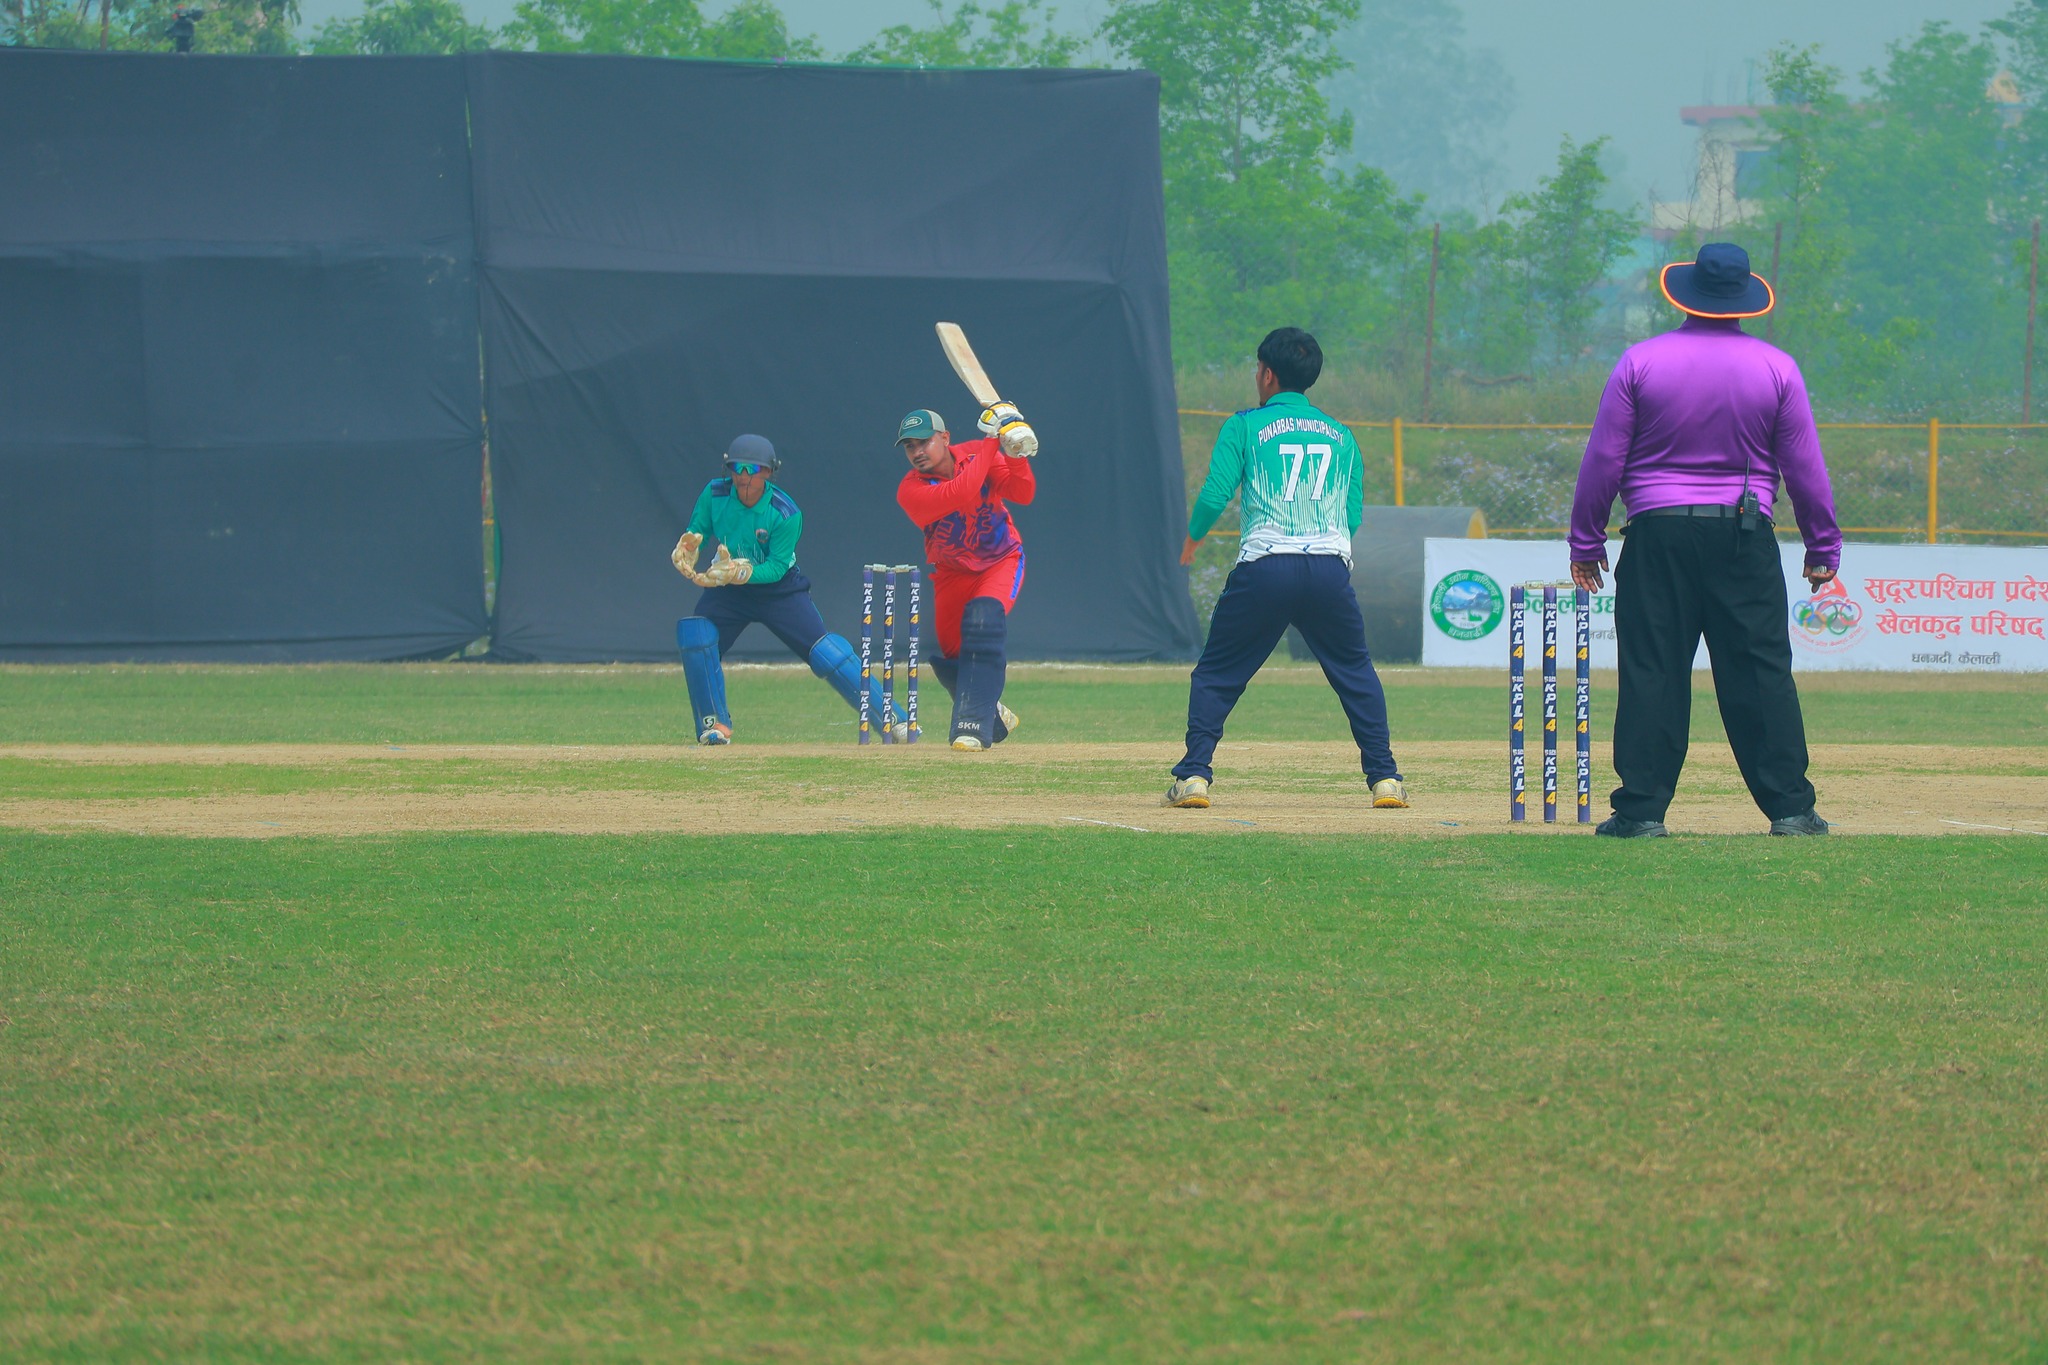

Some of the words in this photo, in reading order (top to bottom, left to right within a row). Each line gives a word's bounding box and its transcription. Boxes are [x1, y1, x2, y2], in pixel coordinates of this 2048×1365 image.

[1258, 417, 1295, 447] PUNARBAS
[1278, 443, 1332, 502] 77
[1864, 572, 1996, 604] सुदूरपश्चिम
[1875, 608, 1963, 640] खेलकुद
[1970, 609, 2047, 641] परिषद्
[957, 721, 980, 731] SKM
